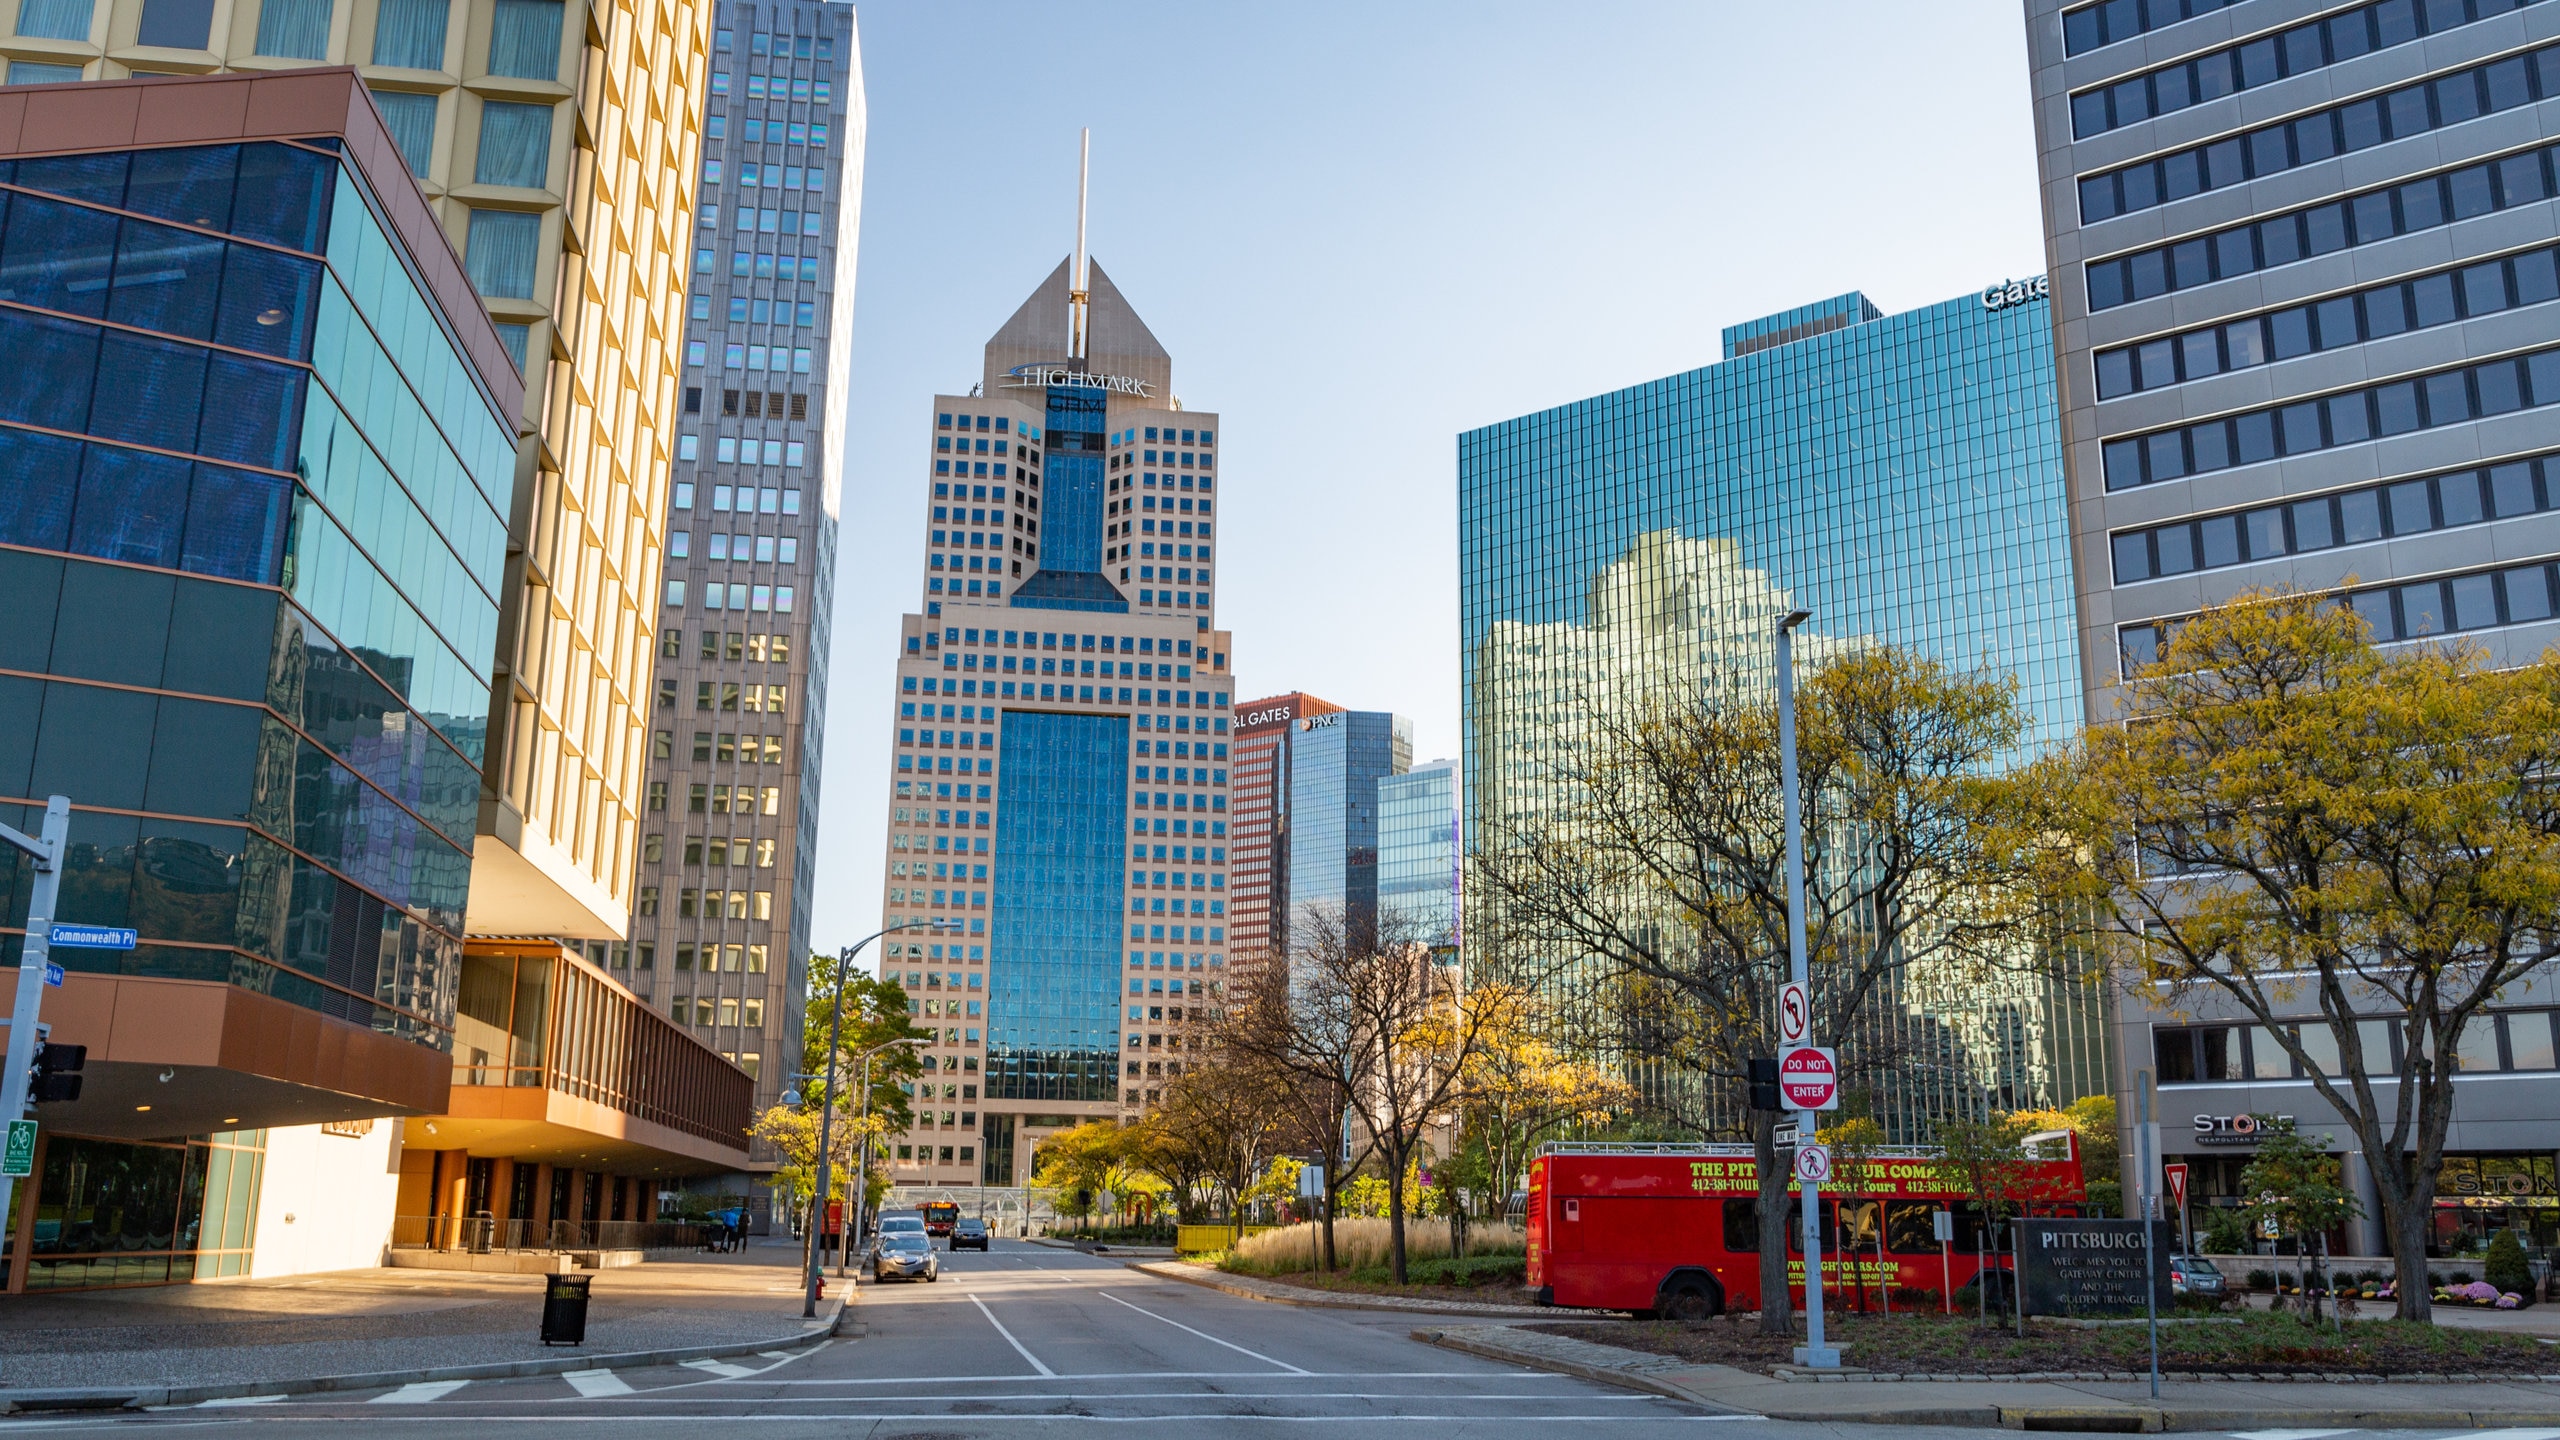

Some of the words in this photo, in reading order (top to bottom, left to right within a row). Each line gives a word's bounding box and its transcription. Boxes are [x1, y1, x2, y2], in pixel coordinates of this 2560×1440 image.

[1023, 364, 1148, 398] HIGHMARK
[1248, 706, 1290, 725] GATES
[1312, 714, 1338, 728] PNC
[52, 928, 121, 945] Commonwealth
[123, 931, 133, 945] Pl
[1788, 1059, 1802, 1070] DO
[1806, 1060, 1826, 1070] NOT
[1793, 1085, 1825, 1097] ENTER
[1776, 1131, 1786, 1141] ONE
[1787, 1130, 1797, 1140] WAY
[1690, 1162, 1725, 1177] THE
[1838, 1164, 1887, 1178] TUR
[1691, 1179, 1759, 1191] 412-381-TOUR
[2052, 1257, 2105, 1267] WELCMES
[2109, 1257, 2130, 1267] YOU
[2134, 1257, 2147, 1267] TO
[2060, 1270, 2102, 1279] GATEWAY
[2106, 1270, 2141, 1279] CENTER
[2081, 1282, 2101, 1291] AND
[2106, 1282, 2123, 1291] THE
[2060, 1294, 2098, 1303] GOLDEN
[2103, 1294, 2146, 1305] TRIANGLE
